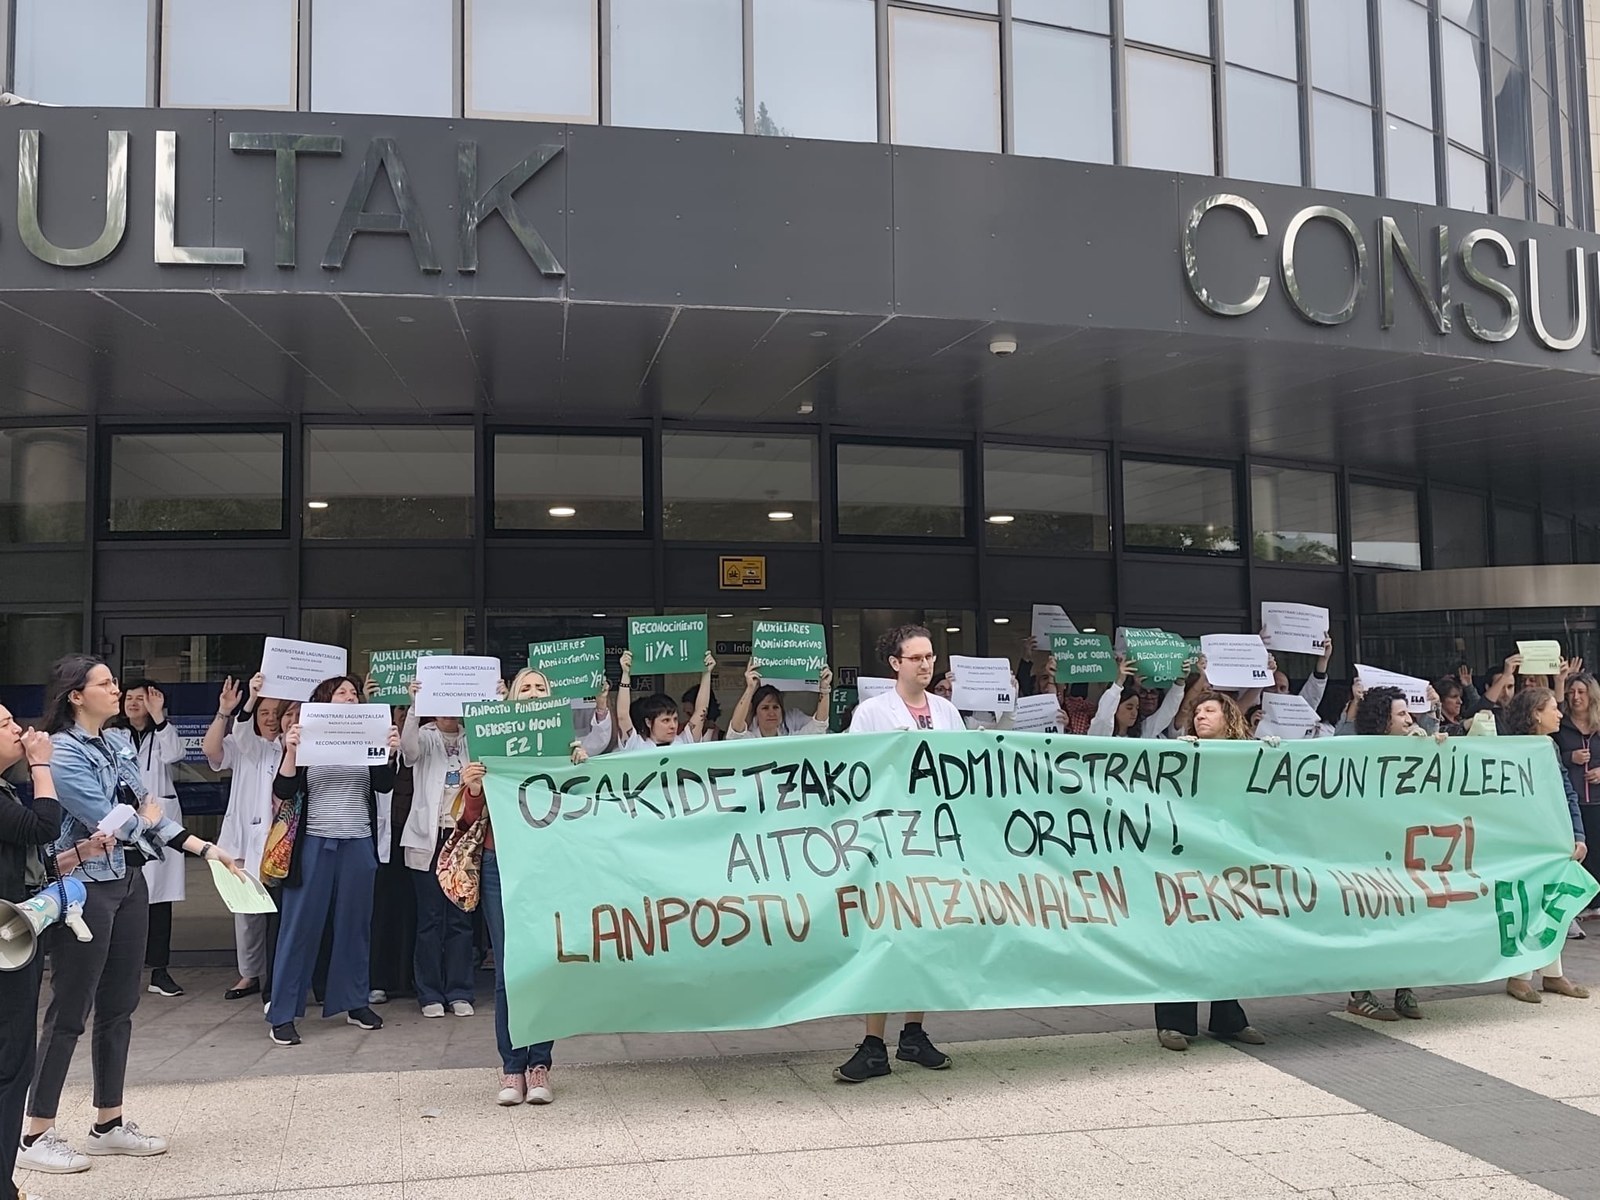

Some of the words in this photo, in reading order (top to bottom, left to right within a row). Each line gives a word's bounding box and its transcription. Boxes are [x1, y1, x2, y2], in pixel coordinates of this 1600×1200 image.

[1182, 193, 1600, 352] CONSU
[632, 620, 704, 635] RECONOCIMIENTO
[756, 622, 810, 634] AUXILIARES
[533, 640, 586, 656] AUXILIARES
[754, 638, 822, 650] ADMINISTRATIVAS
[1054, 637, 1068, 647] NO
[1073, 638, 1101, 646] SOMOS
[372, 650, 433, 662] AUXILIARES
[539, 652, 600, 669] ADMINISTRATIVAS
[1090, 651, 1111, 659] OBRA
[371, 662, 416, 674] ADMINIST
[1070, 664, 1102, 674] BARATA
[400, 674, 416, 683] BIE
[550, 674, 588, 688] ONOCIMIENTO
[374, 684, 408, 697] RETRIB
[832, 690, 847, 702] EZ
[464, 704, 510, 717] LANPOSTU
[476, 720, 525, 737] DEKRETU
[918, 714, 934, 730] BE
[367, 747, 385, 756] ELA
[518, 757, 872, 829] OSAKIDETZAKO
[908, 734, 1200, 800] ADMINISTRARI
[1246, 746, 1536, 798] LAGUNTZAILEEN
[727, 802, 966, 884] AITORTZA
[554, 894, 811, 964] LANPOSTU
[836, 866, 1130, 938] FUNTZIONALEN
[1155, 863, 1318, 927] DEKRETU
[1328, 850, 1416, 920] HONI
[1404, 816, 1490, 908] EZ!
